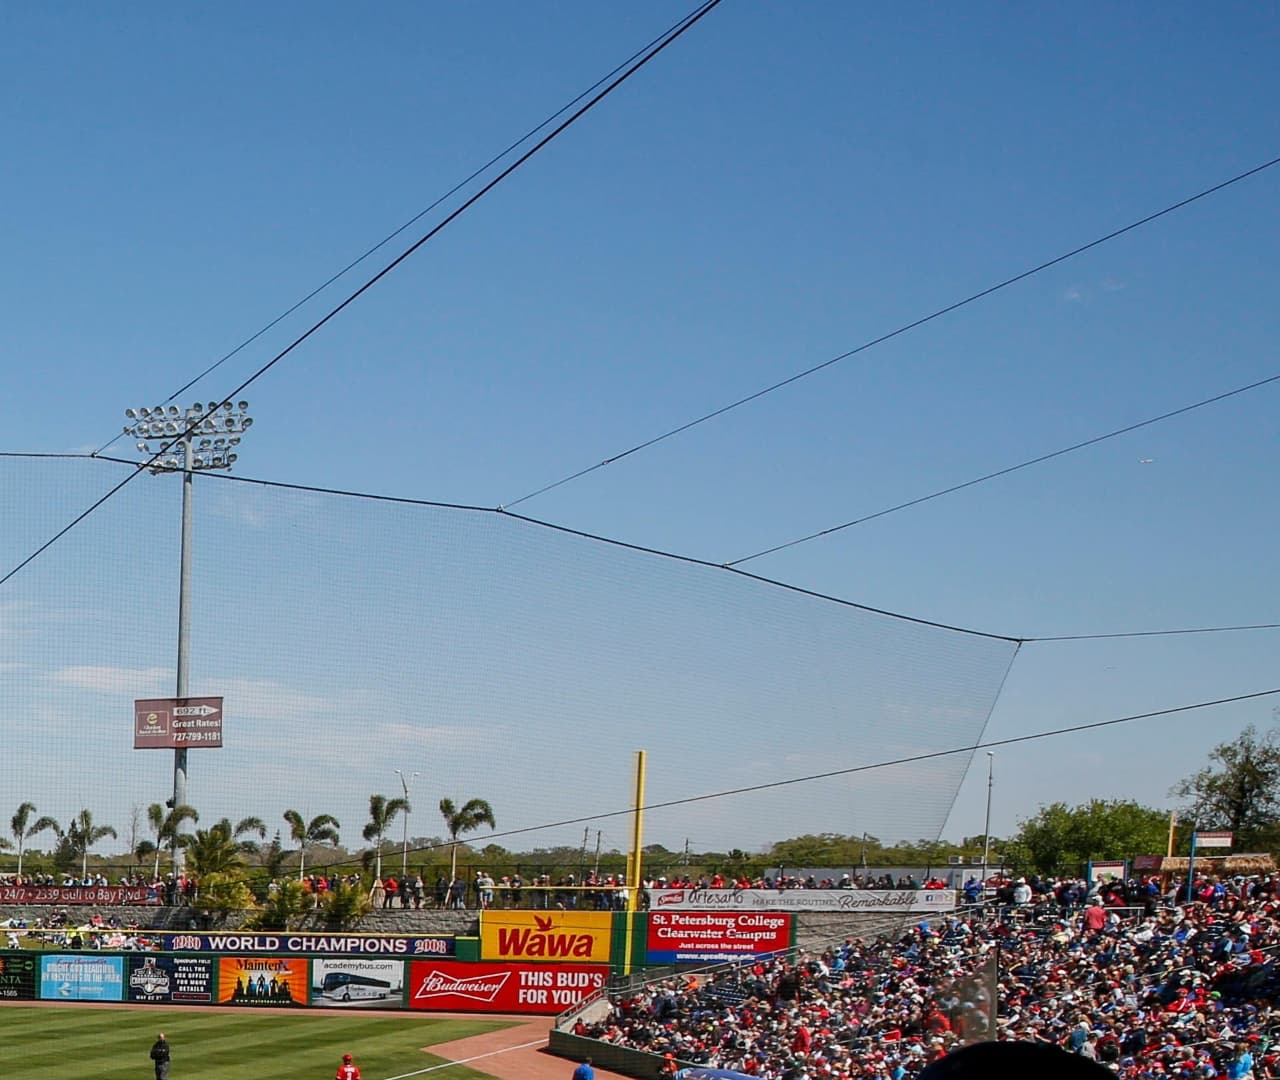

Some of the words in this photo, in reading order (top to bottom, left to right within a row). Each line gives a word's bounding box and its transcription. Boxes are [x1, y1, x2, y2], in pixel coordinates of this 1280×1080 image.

[196, 719, 221, 727] Rates!
[3, 888, 26, 900] 24/7
[35, 889, 60, 900] 2339
[84, 889, 95, 900] to
[97, 888, 116, 902] Bay
[652, 915, 668, 925] St.
[671, 915, 736, 928] Petersburg
[738, 916, 785, 929] College
[657, 928, 723, 939] Clearwater
[726, 929, 777, 941] Campus
[171, 936, 201, 950] 1980
[208, 937, 280, 951] WORLD
[287, 937, 407, 953] CHAMPIONS
[414, 940, 447, 954] 2008
[498, 927, 594, 958] Wawa
[323, 962, 393, 970] academybus.com
[424, 976, 501, 993] Budweiser
[519, 971, 553, 987] THIS
[556, 972, 603, 988] BUD'S
[519, 989, 548, 1004] FOR
